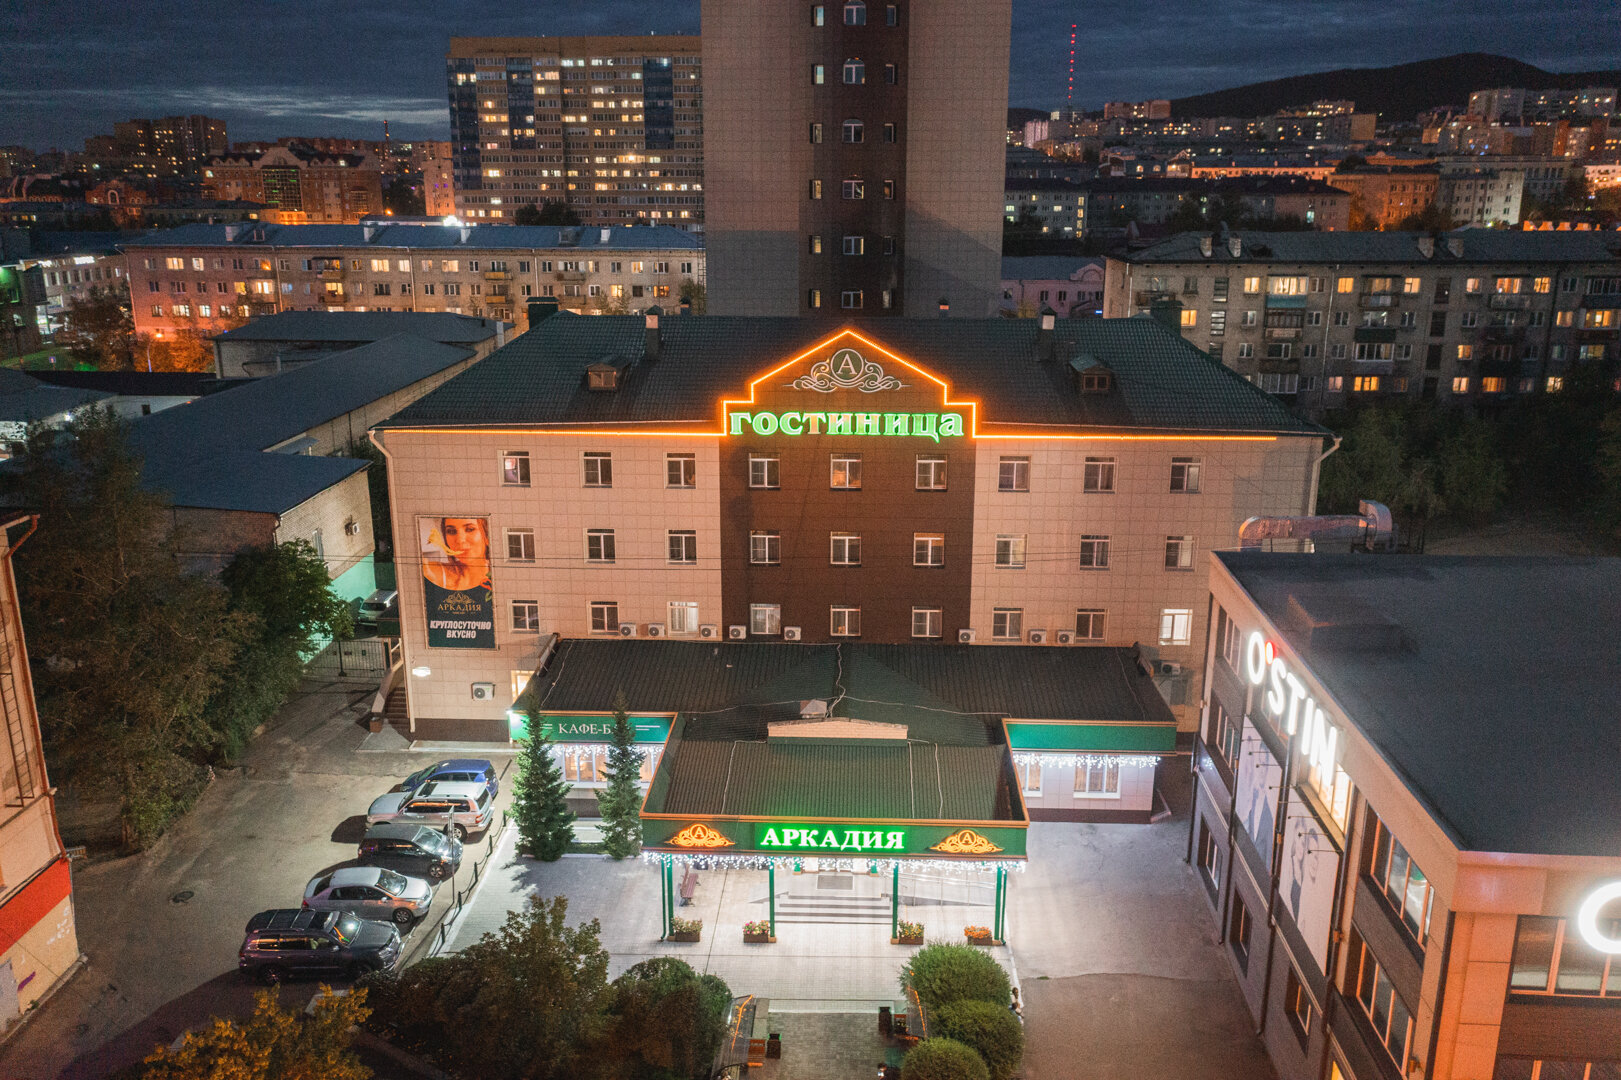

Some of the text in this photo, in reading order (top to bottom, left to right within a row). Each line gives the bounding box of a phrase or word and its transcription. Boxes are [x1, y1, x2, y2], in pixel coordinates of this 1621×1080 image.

[438, 603, 482, 612] АРКАДИЯ
[430, 620, 492, 630] КРУГЛОСУТОЧНО
[446, 629, 477, 639] ВКУСНО
[558, 723, 616, 735] КАФЕ-Б
[760, 828, 905, 851] АРКАДИЯ
